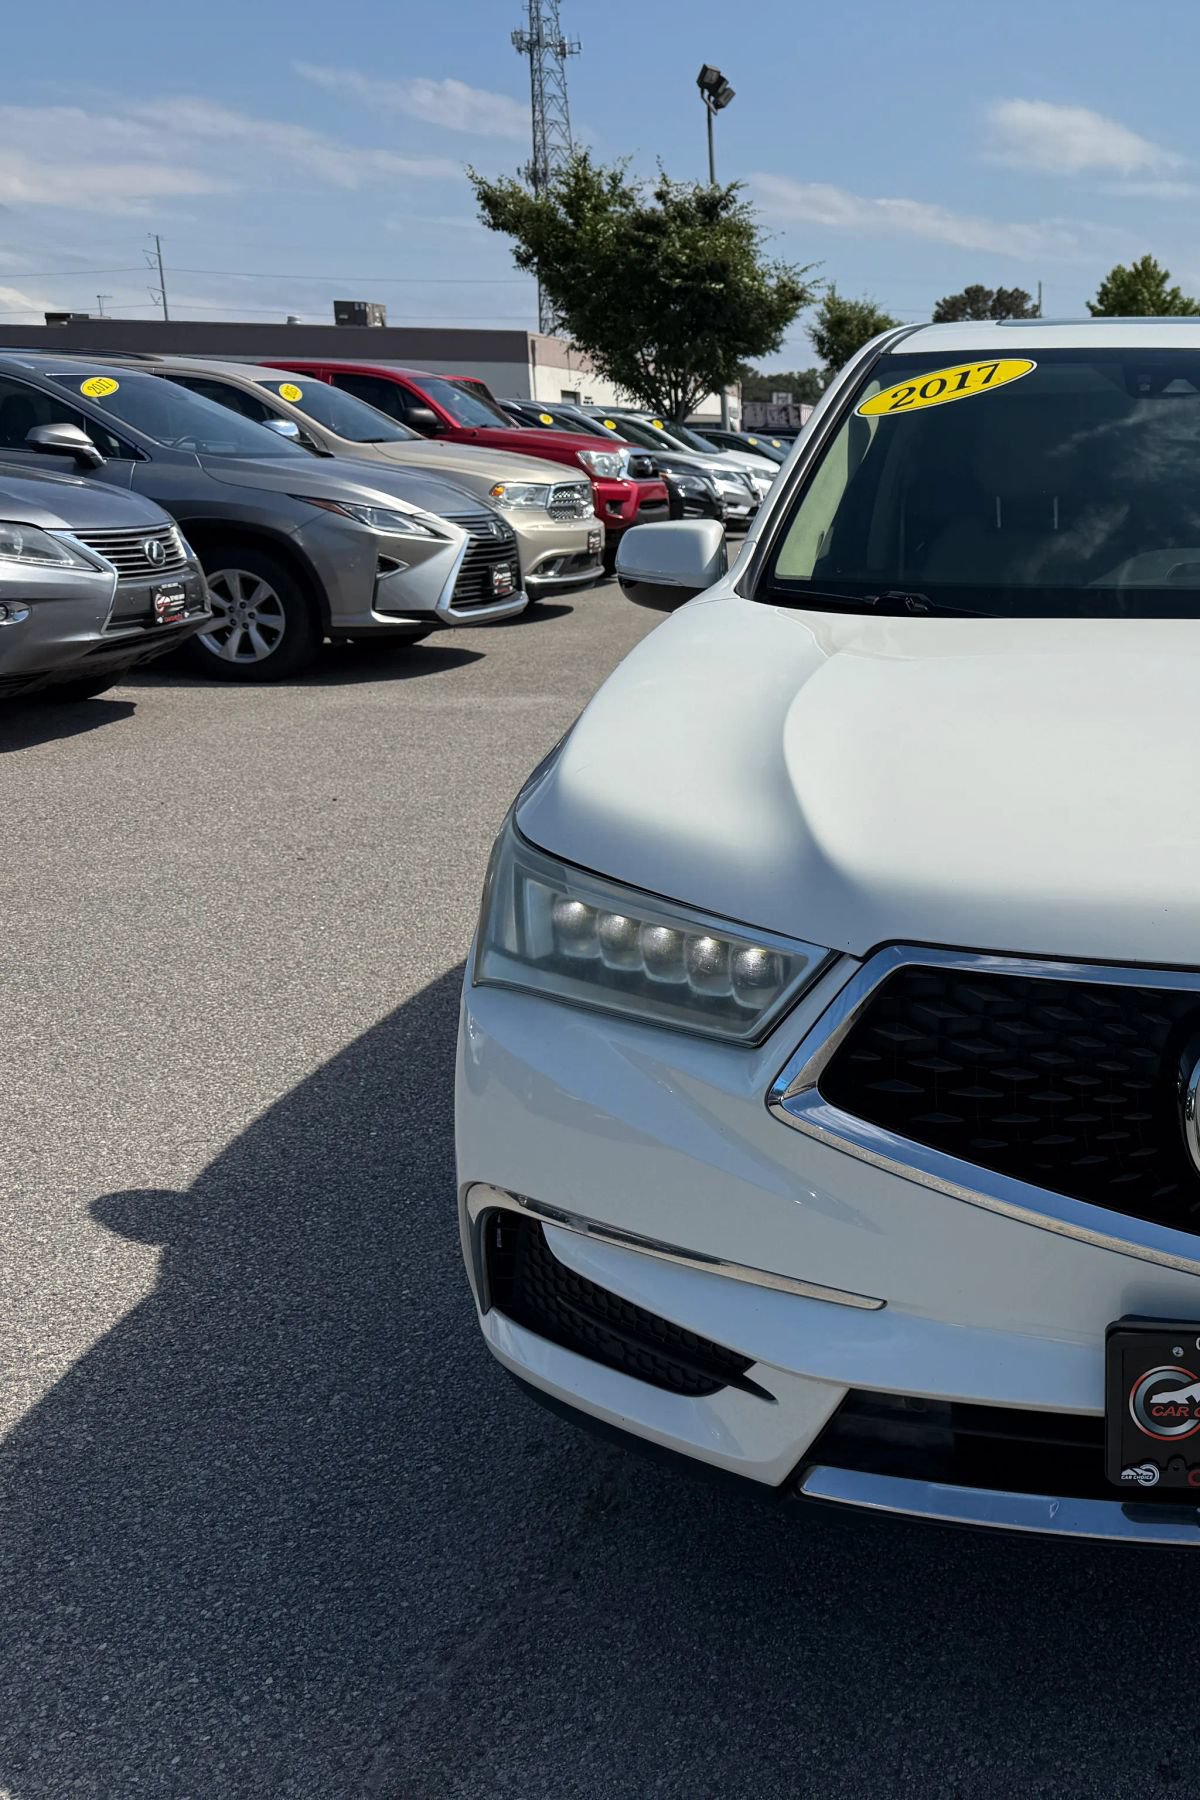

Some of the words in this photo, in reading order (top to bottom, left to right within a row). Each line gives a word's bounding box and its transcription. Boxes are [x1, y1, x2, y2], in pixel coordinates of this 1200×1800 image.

[87, 378, 112, 395] 2017
[889, 363, 1000, 411] 2017
[1151, 1405, 1189, 1418] CAR
